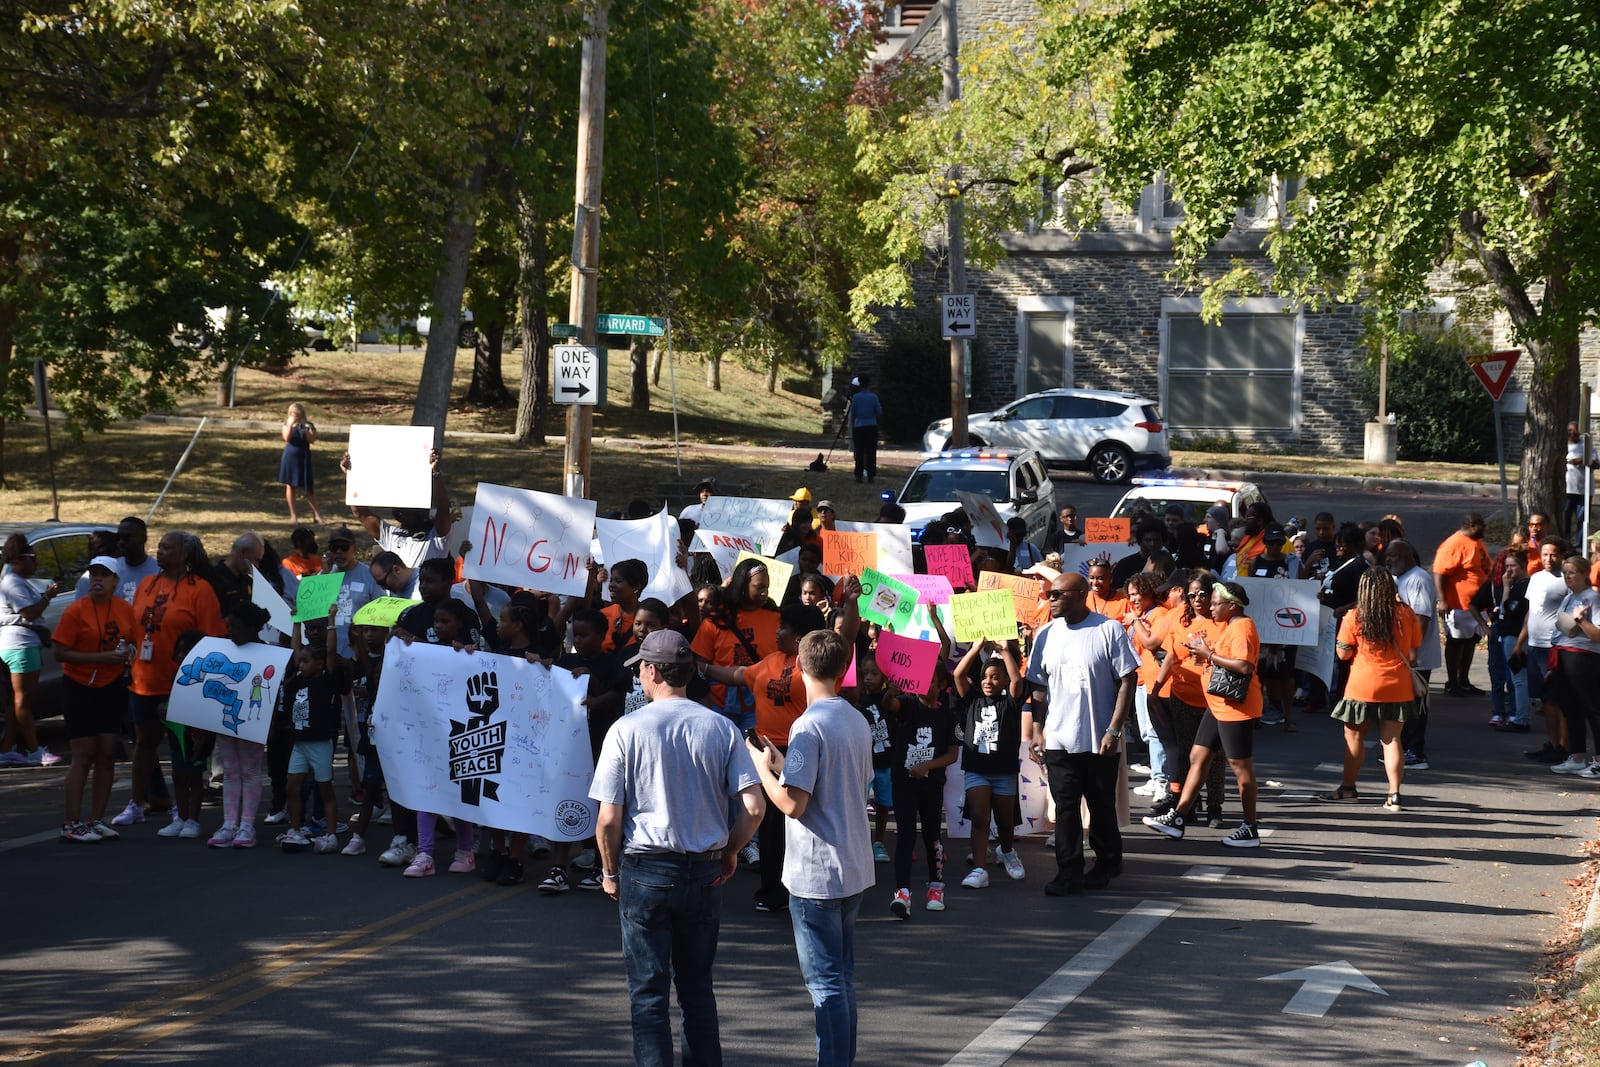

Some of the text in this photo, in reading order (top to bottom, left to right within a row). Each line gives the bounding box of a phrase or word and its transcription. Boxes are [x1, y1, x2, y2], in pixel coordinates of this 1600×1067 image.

[947, 297, 970, 307] ONE
[947, 308, 970, 319] WAY
[598, 318, 646, 331] HARVARD
[561, 350, 591, 364] ONE
[561, 366, 591, 379] WAY
[478, 515, 528, 568] NO
[713, 534, 753, 553] ARMS
[838, 551, 865, 563] KIDS
[952, 595, 982, 613] Hope
[953, 614, 976, 628] Fear
[982, 607, 1007, 624] End
[891, 650, 912, 669] KIDS
[453, 728, 500, 752] YOUTH
[455, 755, 496, 776] PEACE
[571, 802, 587, 817] ZONE
